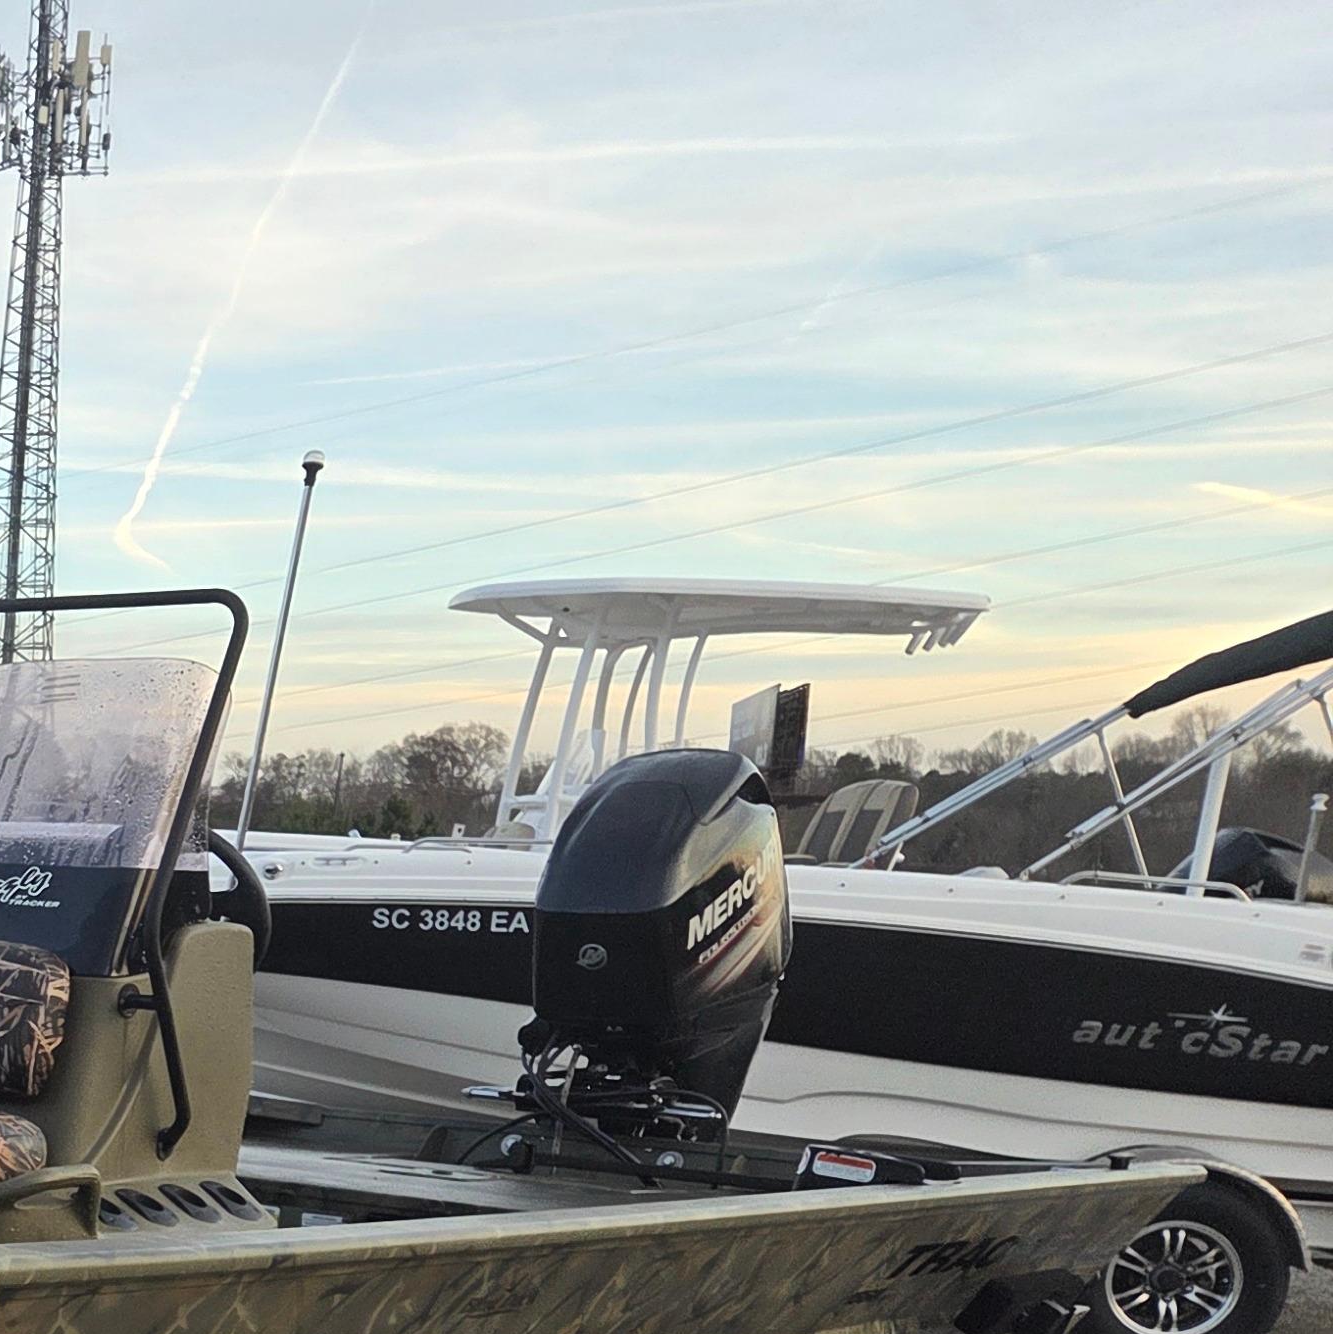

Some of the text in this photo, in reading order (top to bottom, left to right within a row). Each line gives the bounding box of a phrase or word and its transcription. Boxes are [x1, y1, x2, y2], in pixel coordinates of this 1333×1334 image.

[8, 899, 62, 909] TRACKER
[372, 908, 530, 933] SC 3848 EA
